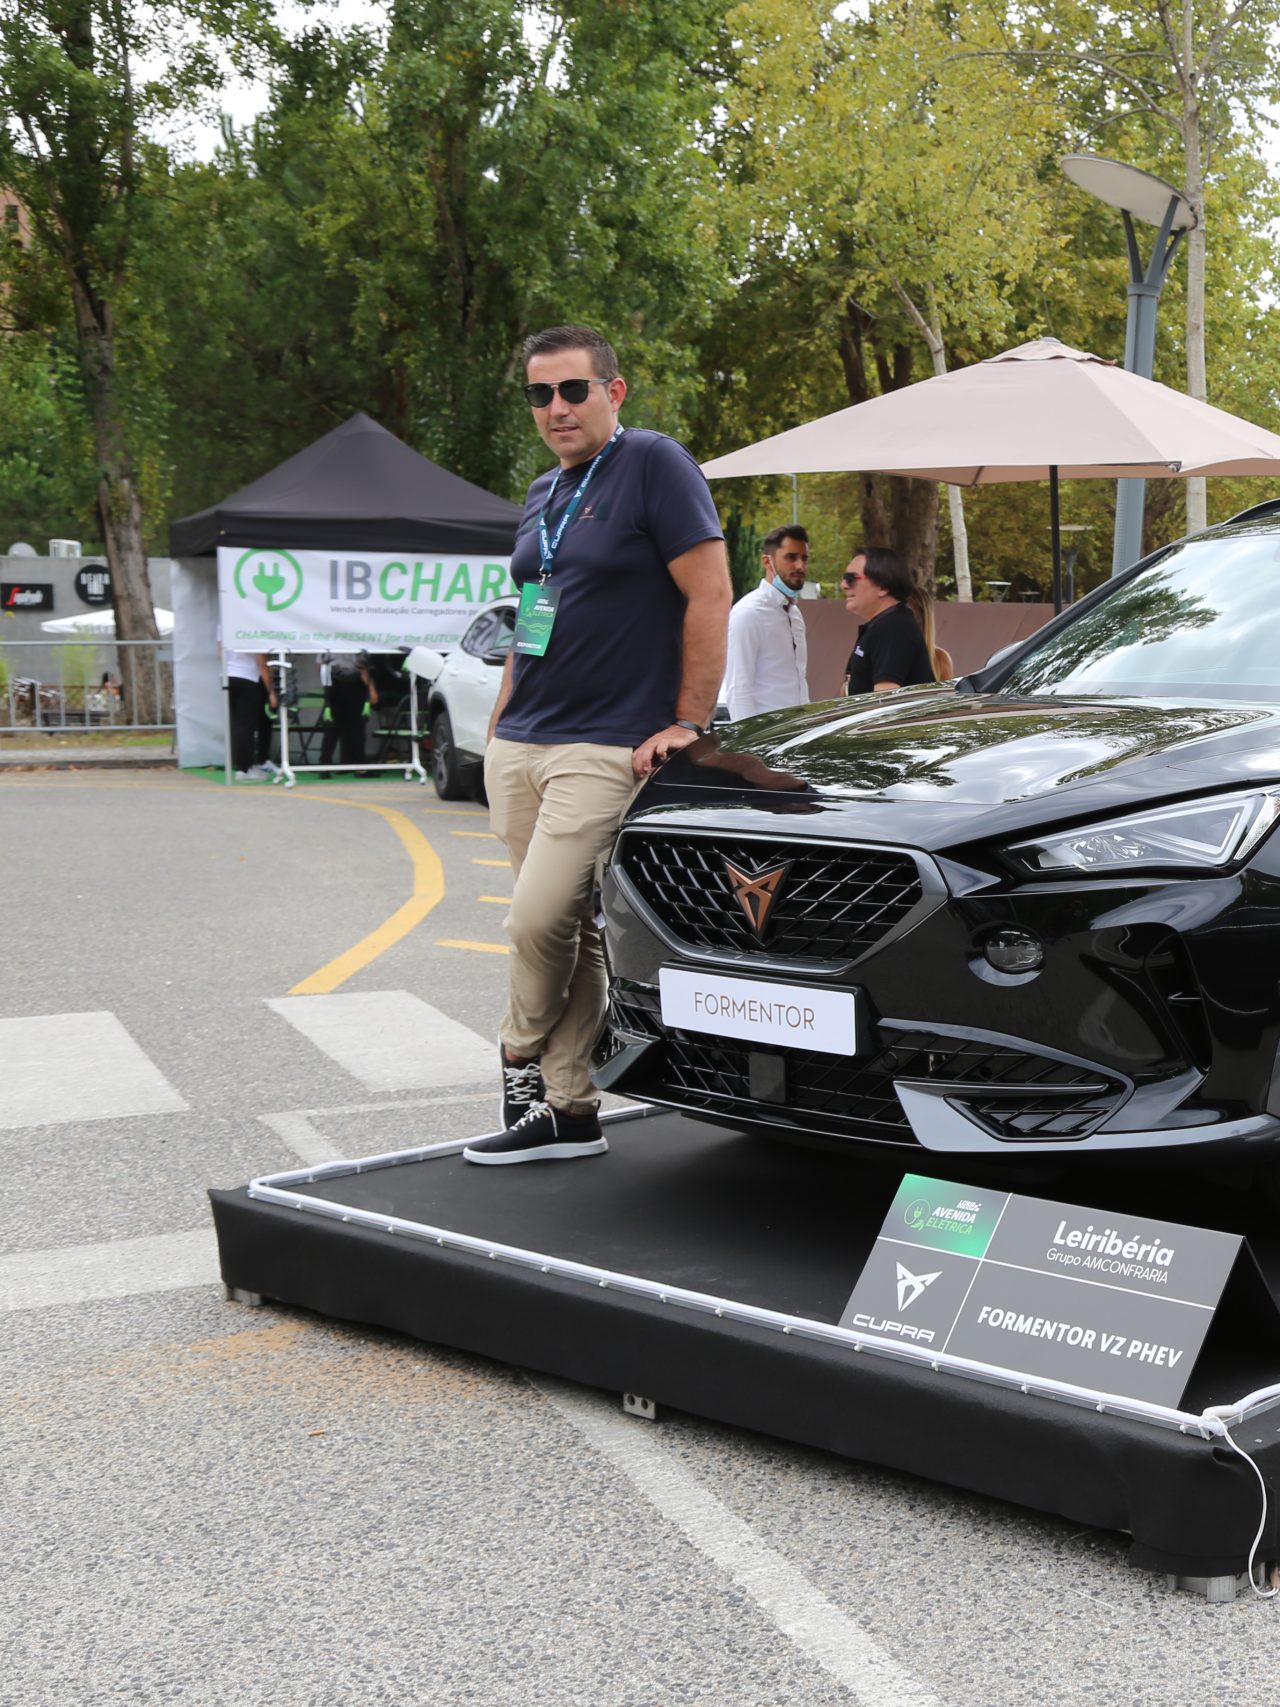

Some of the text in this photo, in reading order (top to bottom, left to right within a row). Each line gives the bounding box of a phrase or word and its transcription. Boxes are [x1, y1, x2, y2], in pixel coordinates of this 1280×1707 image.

[551, 513, 571, 549] CUPRA
[329, 559, 521, 602] IBCHAR
[330, 605, 357, 614] Venda
[234, 630, 297, 641] CHARGING
[313, 632, 332, 641] the
[334, 632, 384, 643] PRESENT
[384, 633, 401, 644] for
[403, 634, 422, 643] the
[694, 991, 815, 1031] FORMENTOR
[931, 1206, 977, 1224] AVENIDA
[1052, 1220, 1175, 1267] Leiribéria
[1046, 1247, 1169, 1284] Grupo AMCONFRARIA
[852, 1313, 936, 1343] CUPRA
[977, 1305, 1184, 1368] FORMENTOR VZ PHEV
